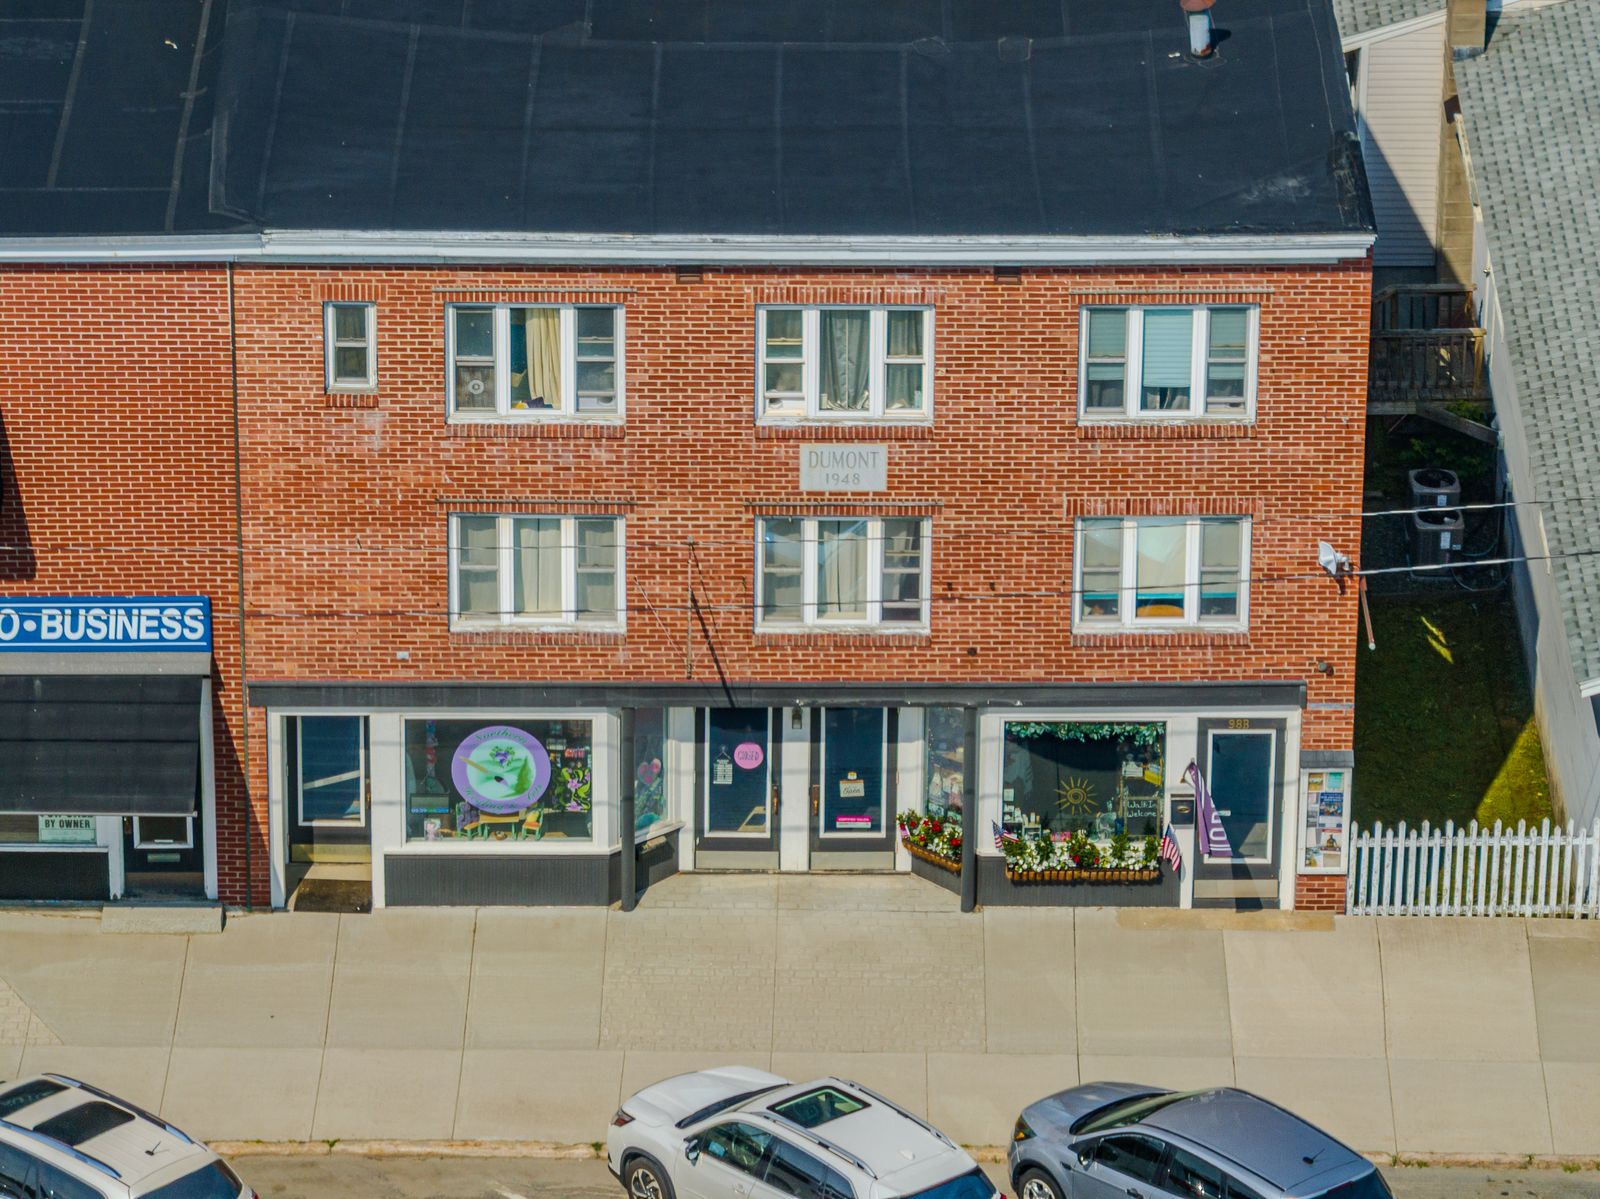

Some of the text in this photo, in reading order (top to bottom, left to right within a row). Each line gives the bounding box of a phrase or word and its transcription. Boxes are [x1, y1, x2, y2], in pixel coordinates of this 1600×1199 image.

[808, 451, 880, 469] DUMONT
[825, 472, 861, 486] 1948
[41, 608, 205, 640] BUSINESS
[45, 819, 91, 828] BY OWNER
